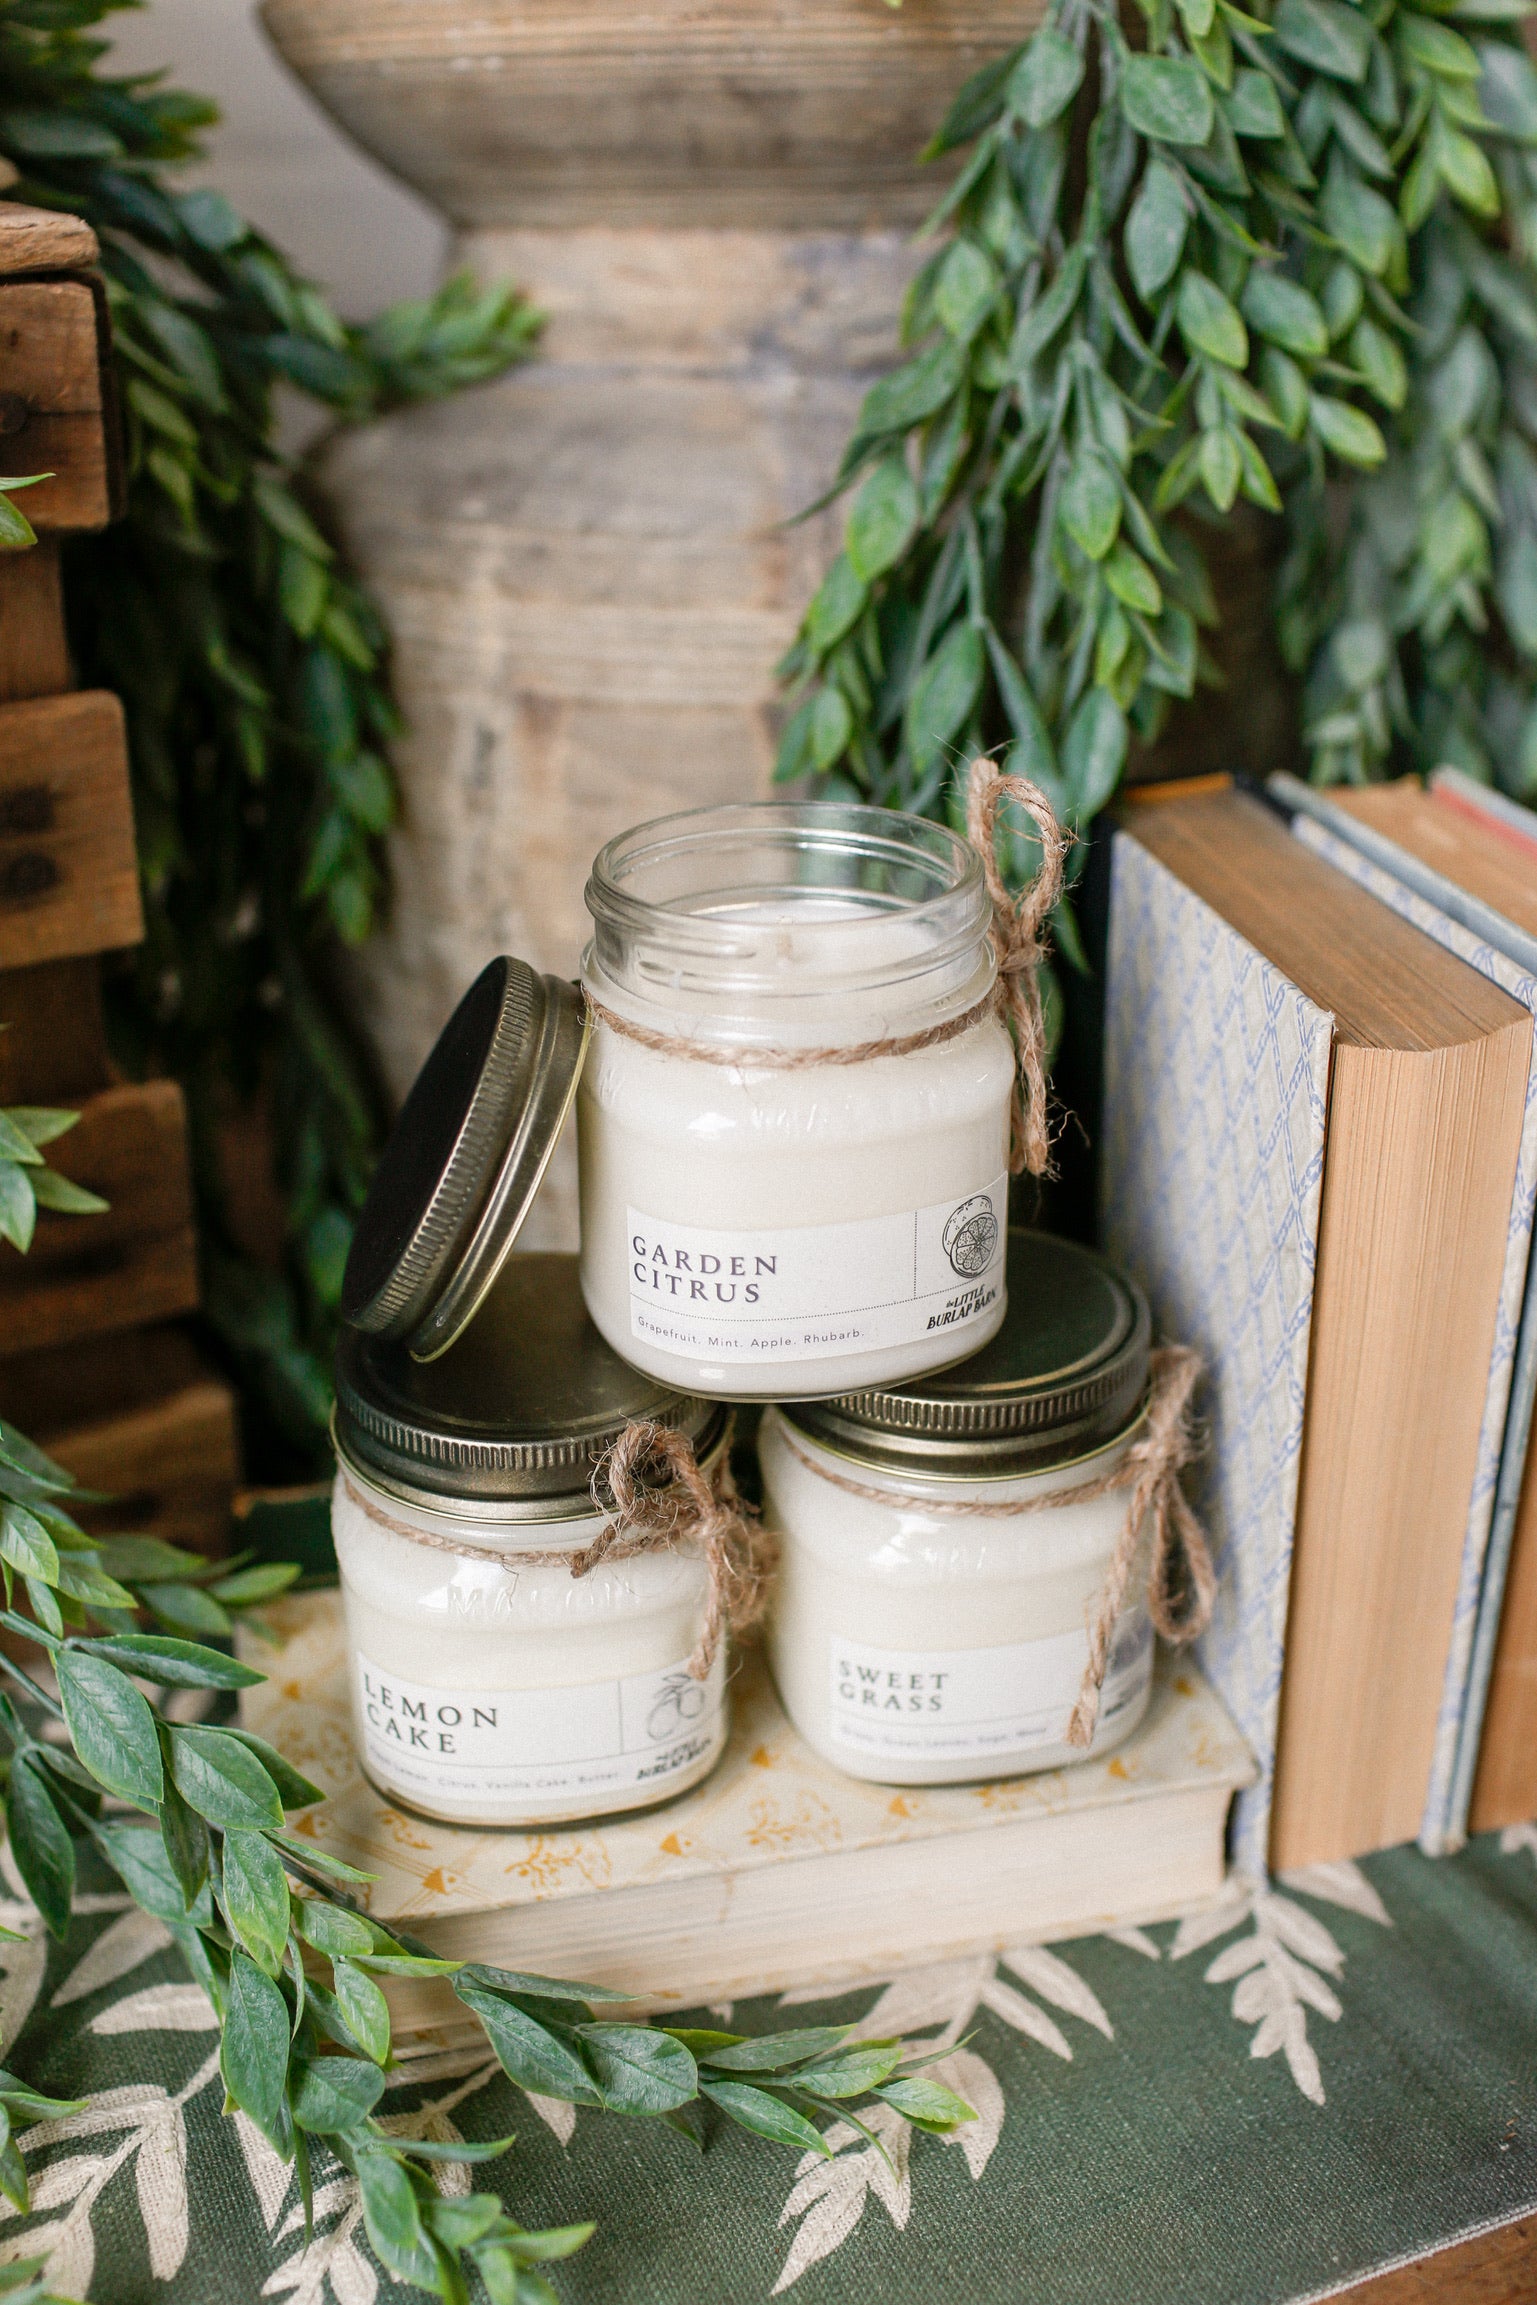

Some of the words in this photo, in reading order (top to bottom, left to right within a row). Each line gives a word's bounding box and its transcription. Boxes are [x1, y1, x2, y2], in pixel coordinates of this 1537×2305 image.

[632, 1235, 779, 1276] GARDEN
[633, 1261, 761, 1303] CITRUS
[638, 1315, 702, 1345] Grapefruit.
[708, 1336, 744, 1348] Mint.
[750, 1337, 797, 1350] Apple.
[803, 1328, 866, 1344] Rhubarb.
[926, 1303, 973, 1330] BURLAP
[839, 1659, 949, 1690] SWEET
[364, 1672, 499, 1729] LEMON
[839, 1681, 943, 1712] GRASS
[367, 1702, 457, 1755] CAKE
